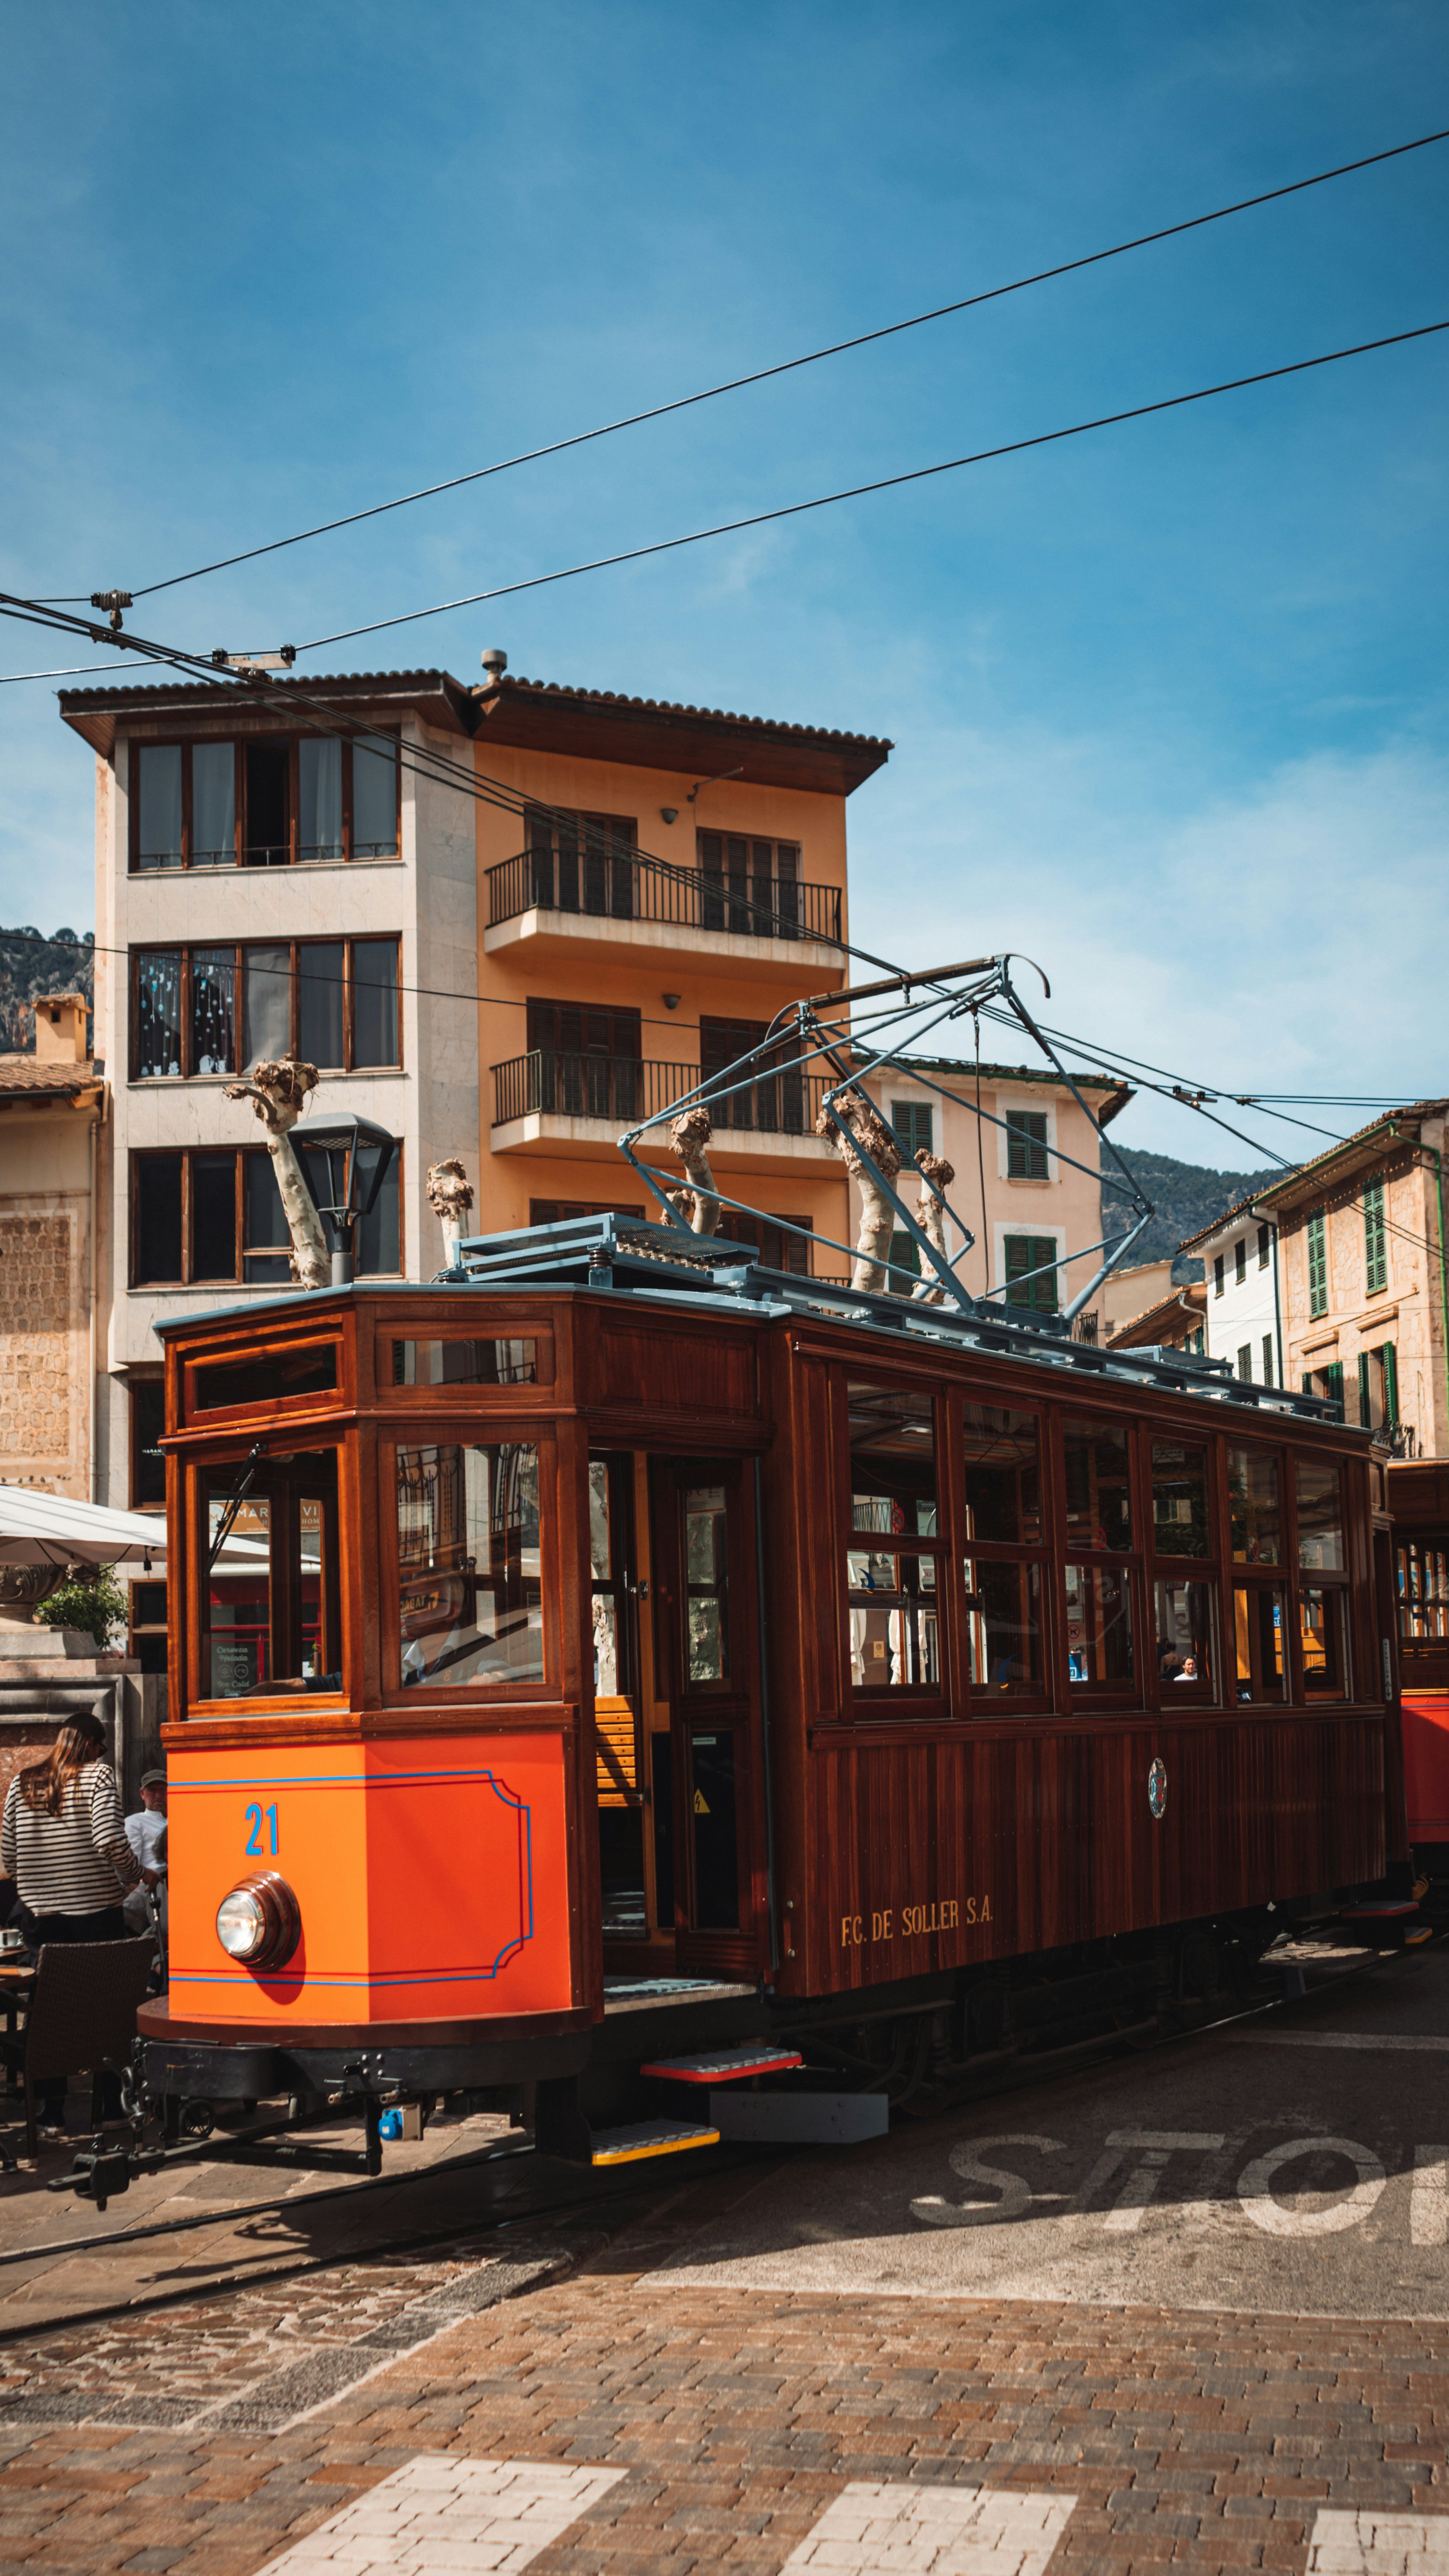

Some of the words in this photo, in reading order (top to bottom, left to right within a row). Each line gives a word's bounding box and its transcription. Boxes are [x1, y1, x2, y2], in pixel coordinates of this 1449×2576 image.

[245, 1802, 279, 1856] 21
[841, 1915, 867, 1946] F.C.
[872, 1909, 893, 1941] DE
[902, 1900, 959, 1936] SOLLER
[966, 1895, 993, 1925] S.A.
